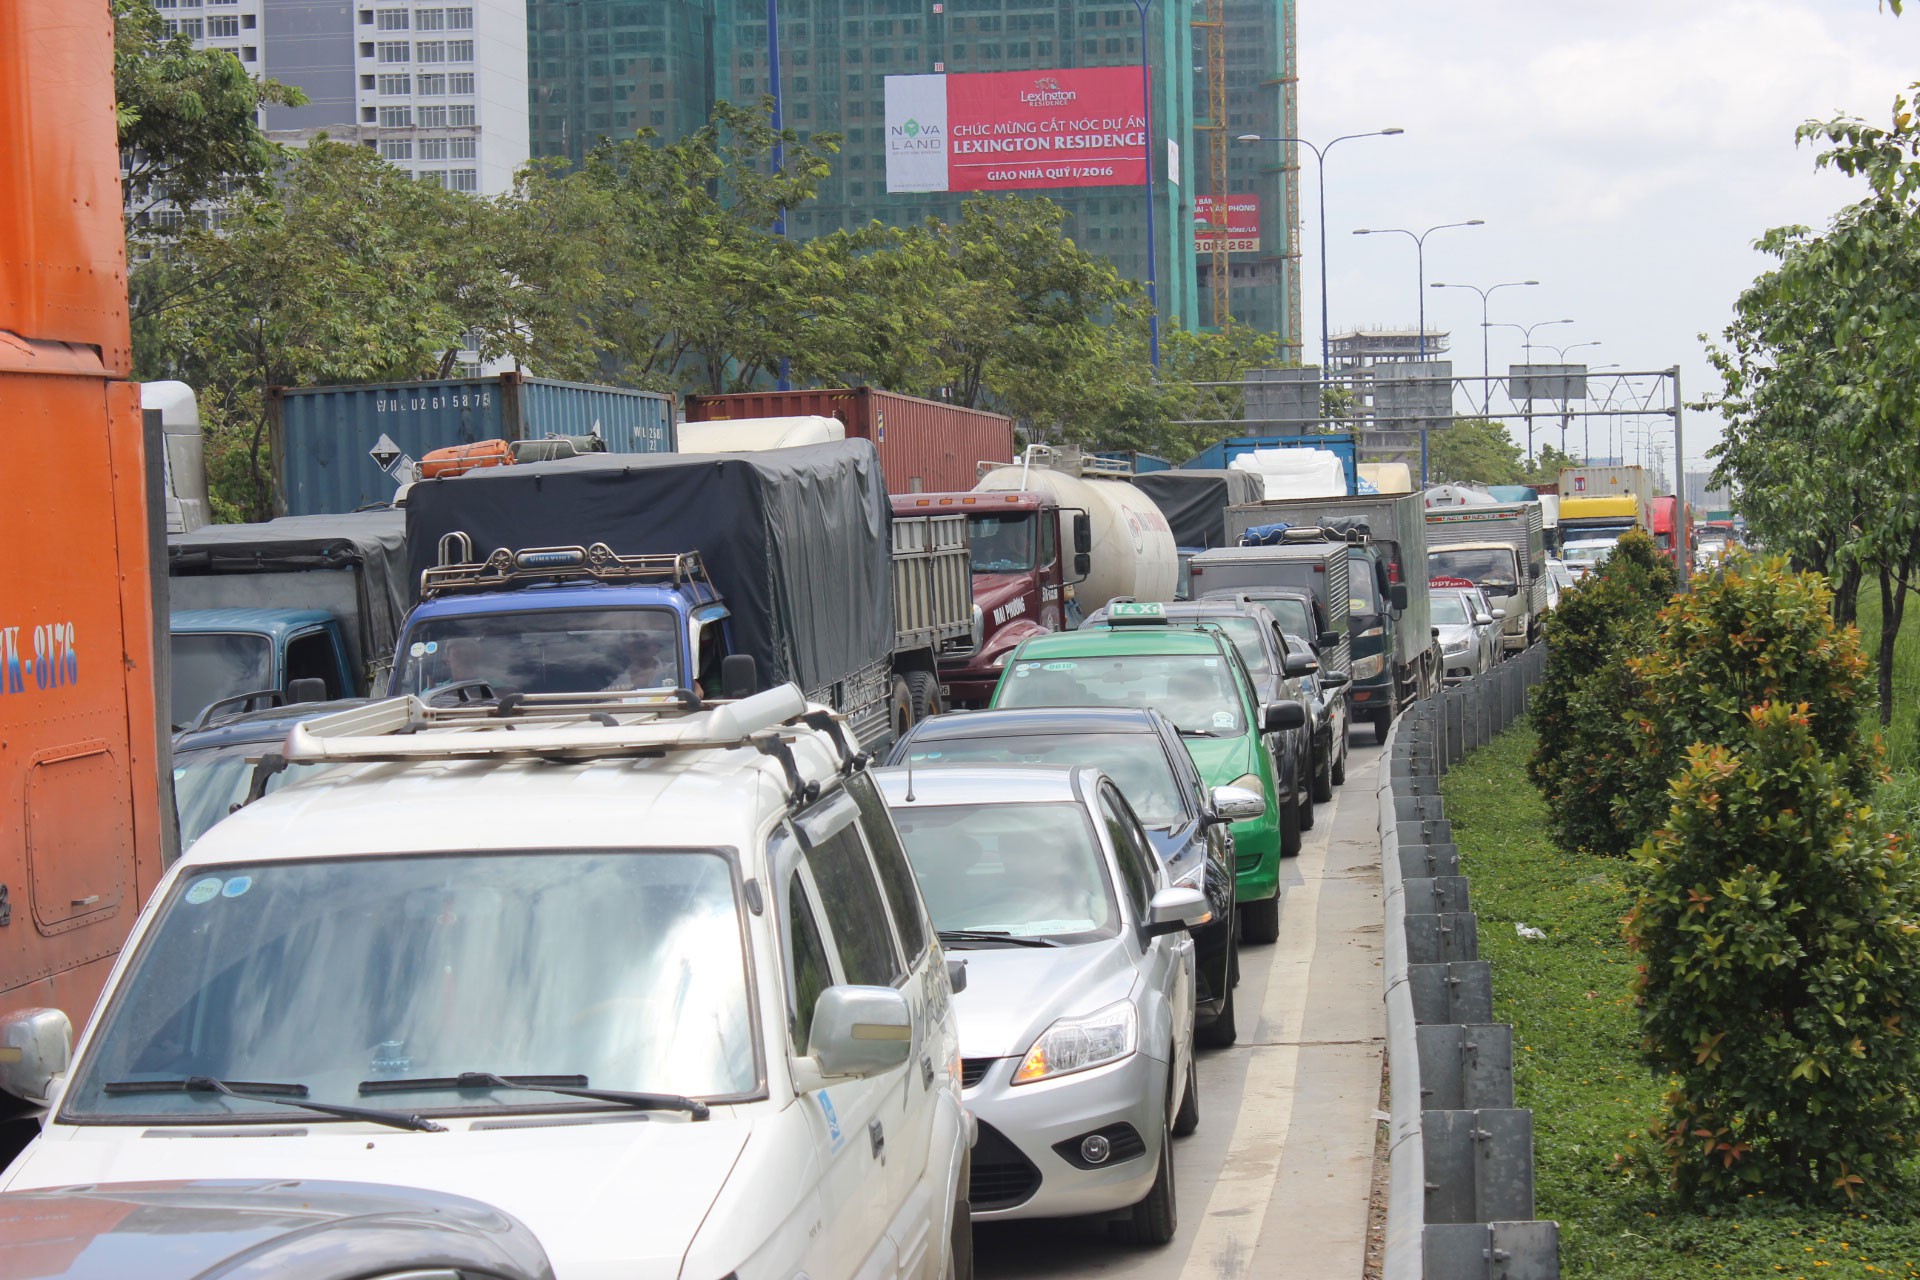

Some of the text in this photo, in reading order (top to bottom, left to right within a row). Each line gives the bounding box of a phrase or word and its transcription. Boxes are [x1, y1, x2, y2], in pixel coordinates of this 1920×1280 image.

[1020, 90, 1076, 102] Lexington
[953, 122, 991, 136] CHÚC
[994, 120, 1037, 135] MỪNG
[1069, 117, 1099, 131] NÓC
[1102, 118, 1123, 132] DỰ
[1125, 115, 1146, 128] ÁN
[891, 139, 941, 150] LAND
[953, 132, 1146, 154] LEXINGTON RESIDENCE
[987, 170, 1017, 181] GIAO
[1019, 168, 1044, 180] NHÀ
[1045, 166, 1071, 179] QUÝ
